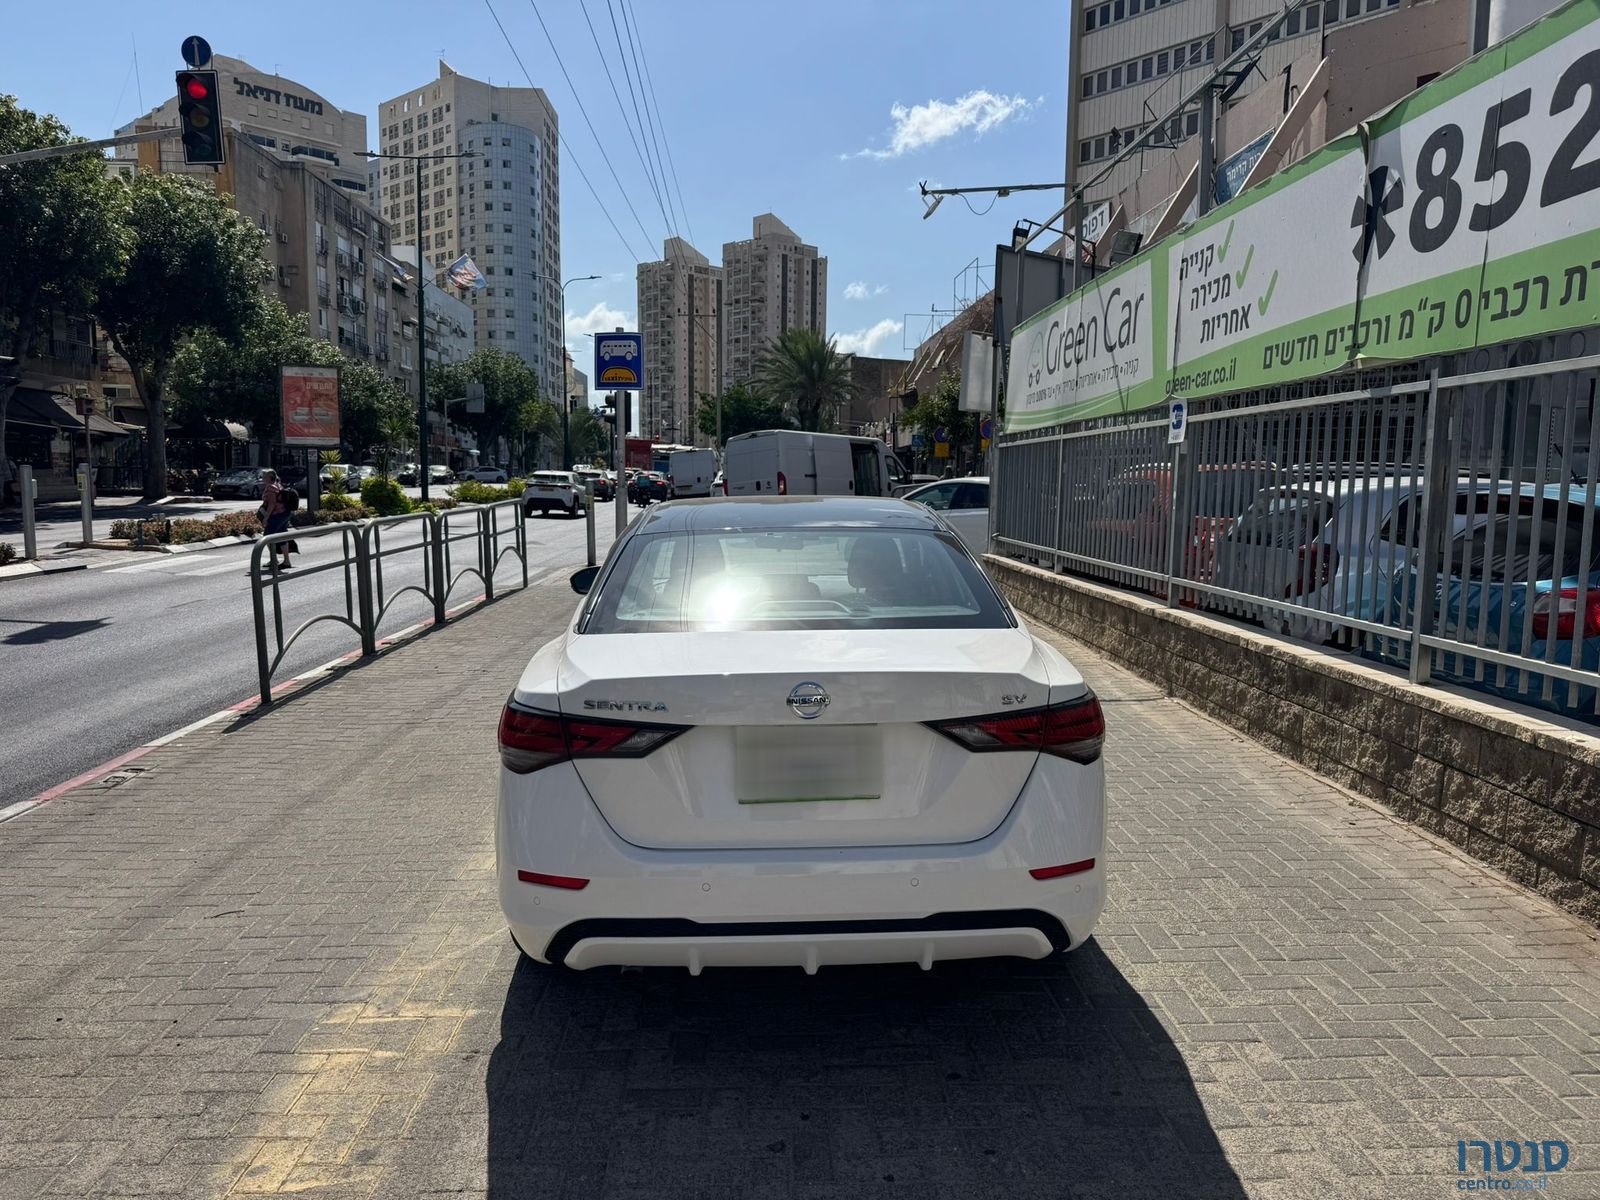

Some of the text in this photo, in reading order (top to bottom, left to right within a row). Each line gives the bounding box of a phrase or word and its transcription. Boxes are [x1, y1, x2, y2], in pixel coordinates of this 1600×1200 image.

[233, 76, 281, 105] דניאל
[1180, 243, 1215, 281] קנייה
[1190, 272, 1231, 311] מכירה
[1482, 275, 1549, 323] רכבי
[1560, 260, 1600, 306] ת
[1200, 303, 1252, 344] אחריות
[1455, 288, 1472, 329] 0
[1046, 287, 1145, 375] Green Car
[1324, 314, 1392, 356] ורכבים
[1263, 334, 1318, 370] חדשים
[583, 699, 669, 712] SENTRA
[790, 696, 827, 706] NISSAN
[1001, 694, 1027, 705] SV
